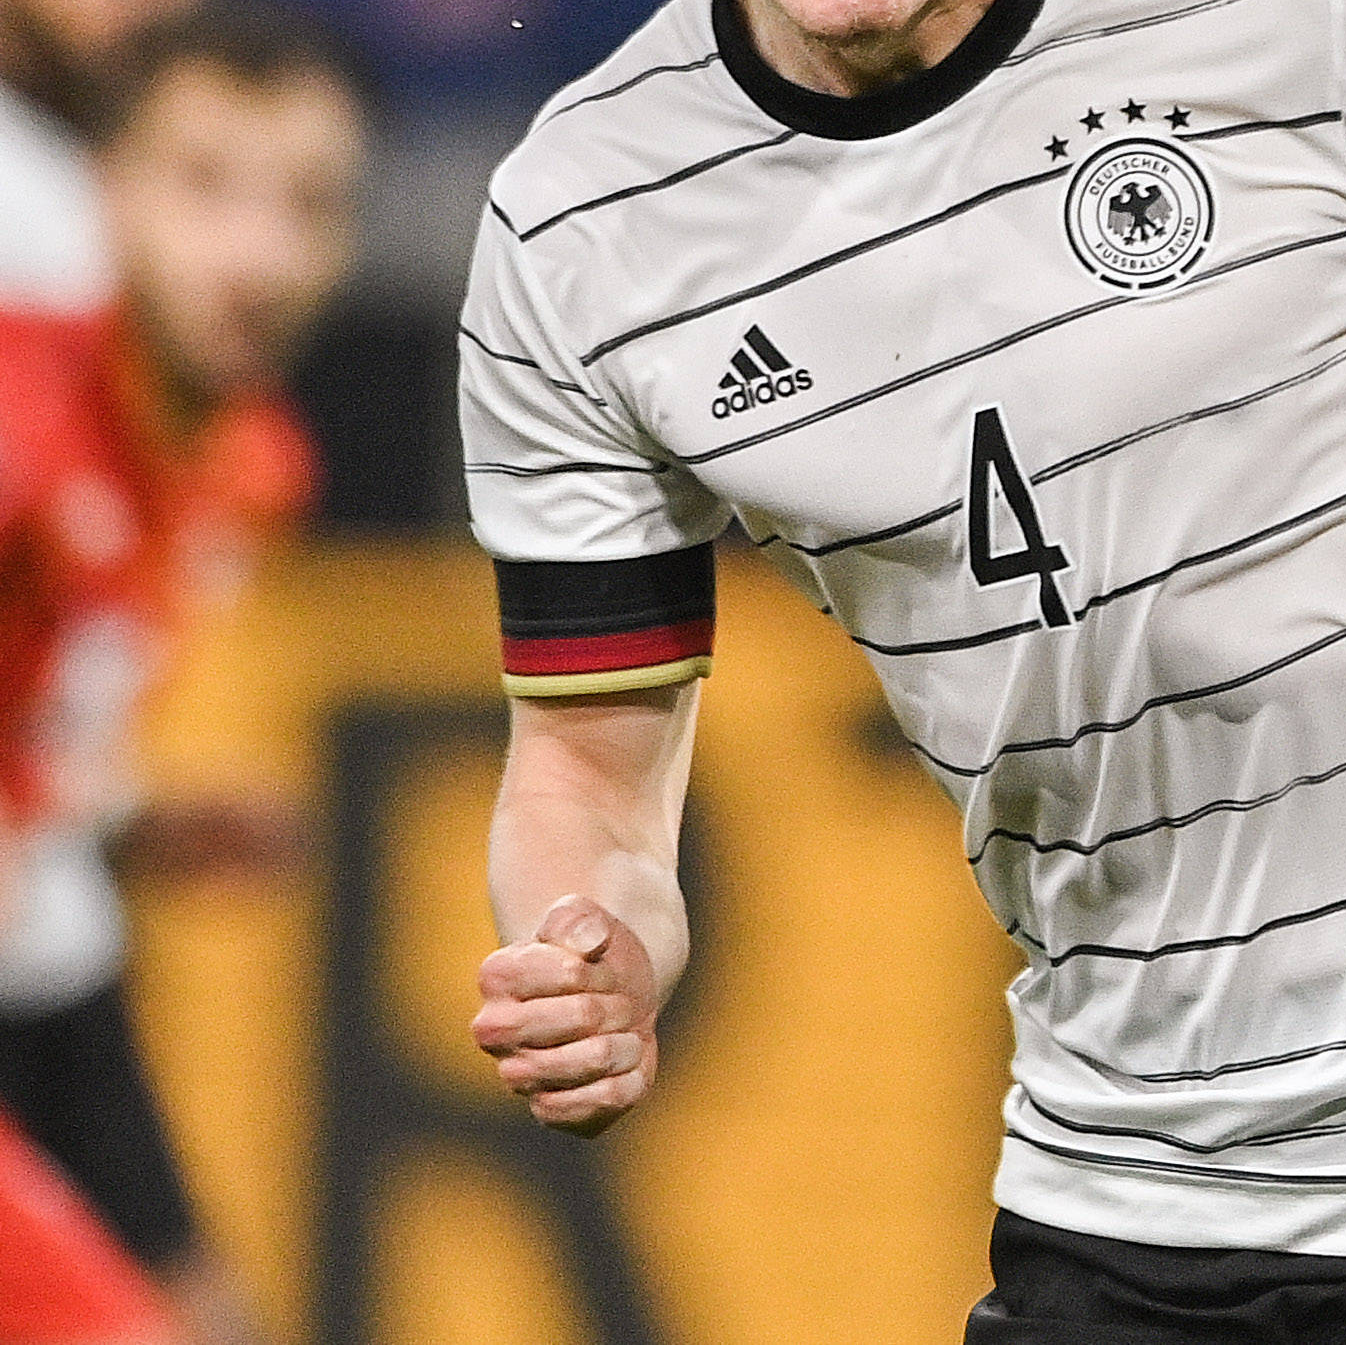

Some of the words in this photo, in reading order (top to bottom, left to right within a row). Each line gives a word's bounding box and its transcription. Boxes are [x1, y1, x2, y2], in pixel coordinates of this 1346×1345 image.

[1090, 158, 1170, 196] DEUTSCHER
[1094, 216, 1194, 270] FUSSBALL-BUND
[712, 367, 813, 419] adidas
[968, 406, 1072, 628] 4
